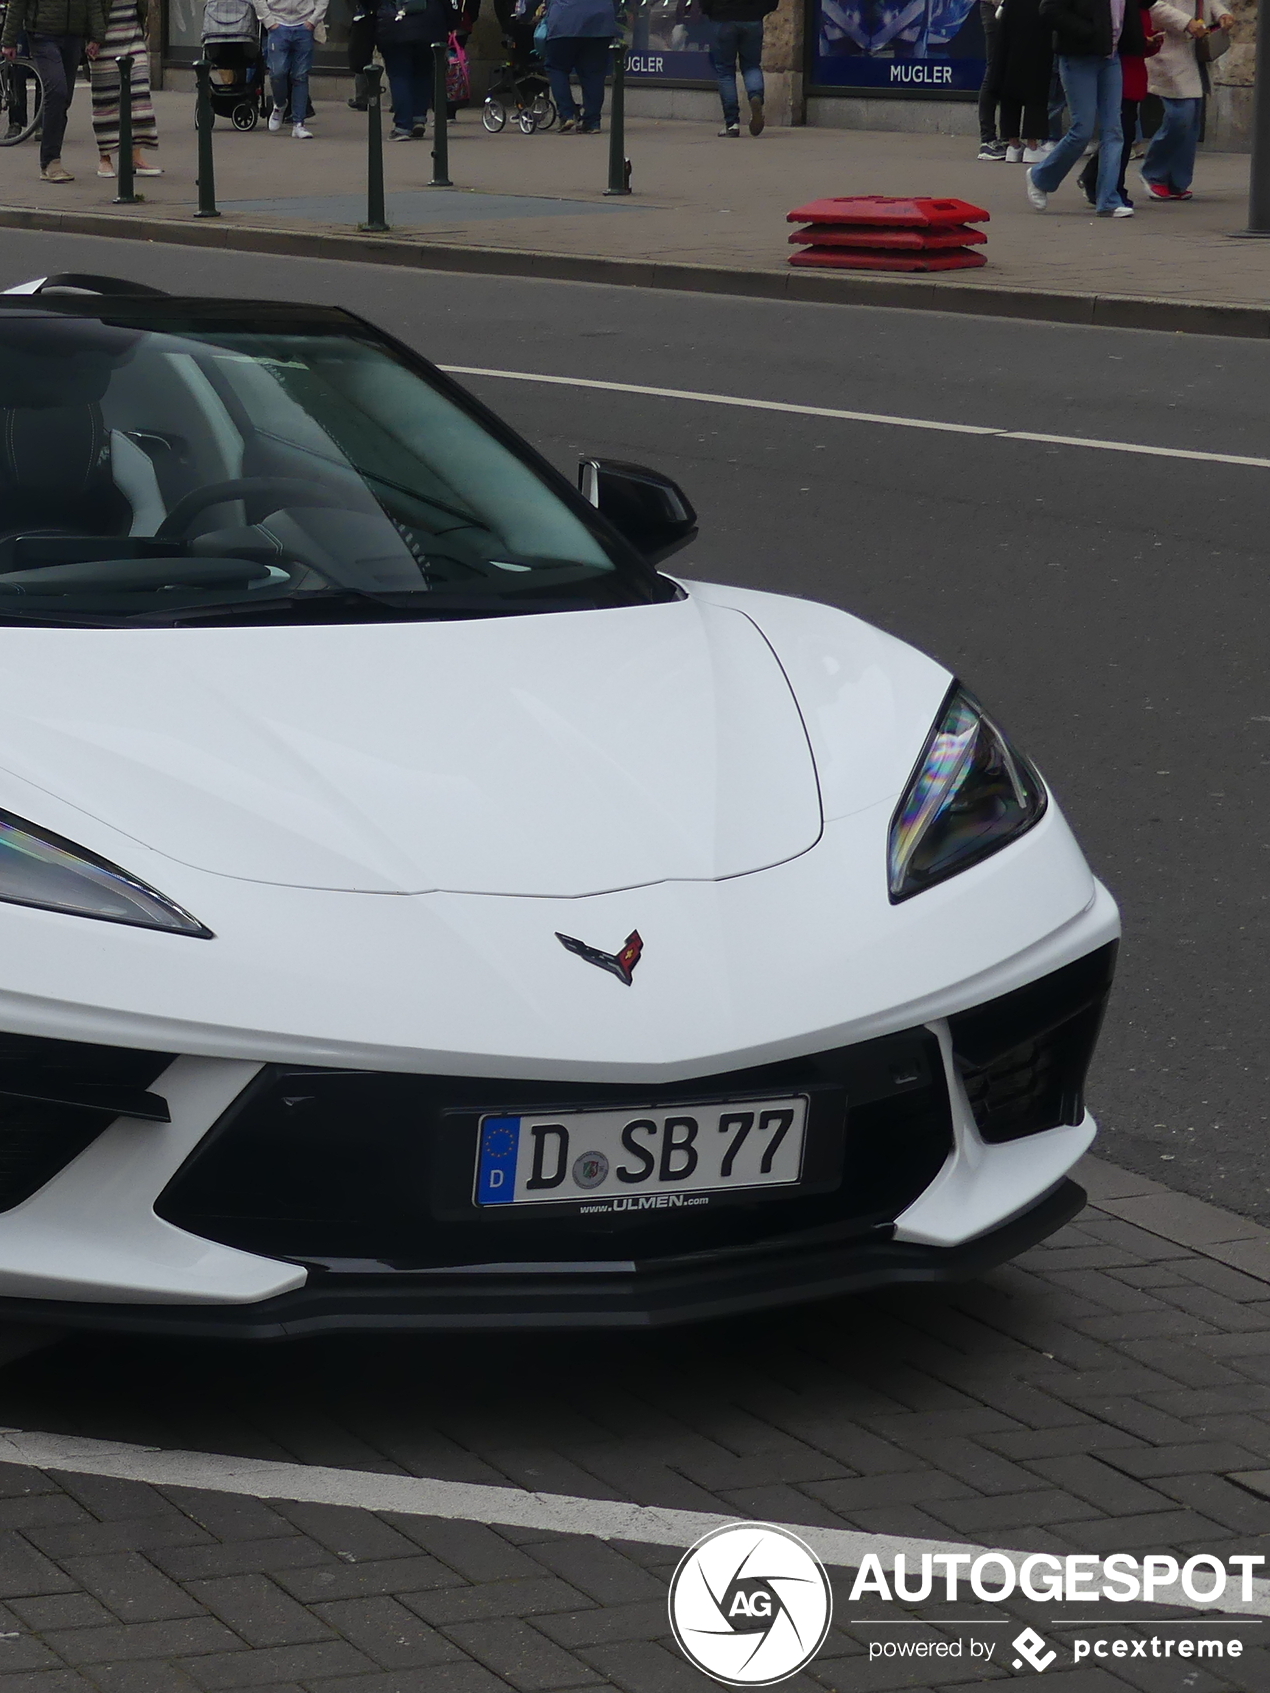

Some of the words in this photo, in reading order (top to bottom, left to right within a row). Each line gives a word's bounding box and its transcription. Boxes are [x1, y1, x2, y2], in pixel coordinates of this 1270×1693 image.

[624, 56, 664, 72] UGLER
[890, 65, 952, 83] MUGLER
[526, 1123, 569, 1190] D
[616, 1116, 698, 1183] SB
[718, 1108, 794, 1177] 77
[489, 1169, 504, 1188] D
[580, 1195, 709, 1213] www.ULMEN.com
